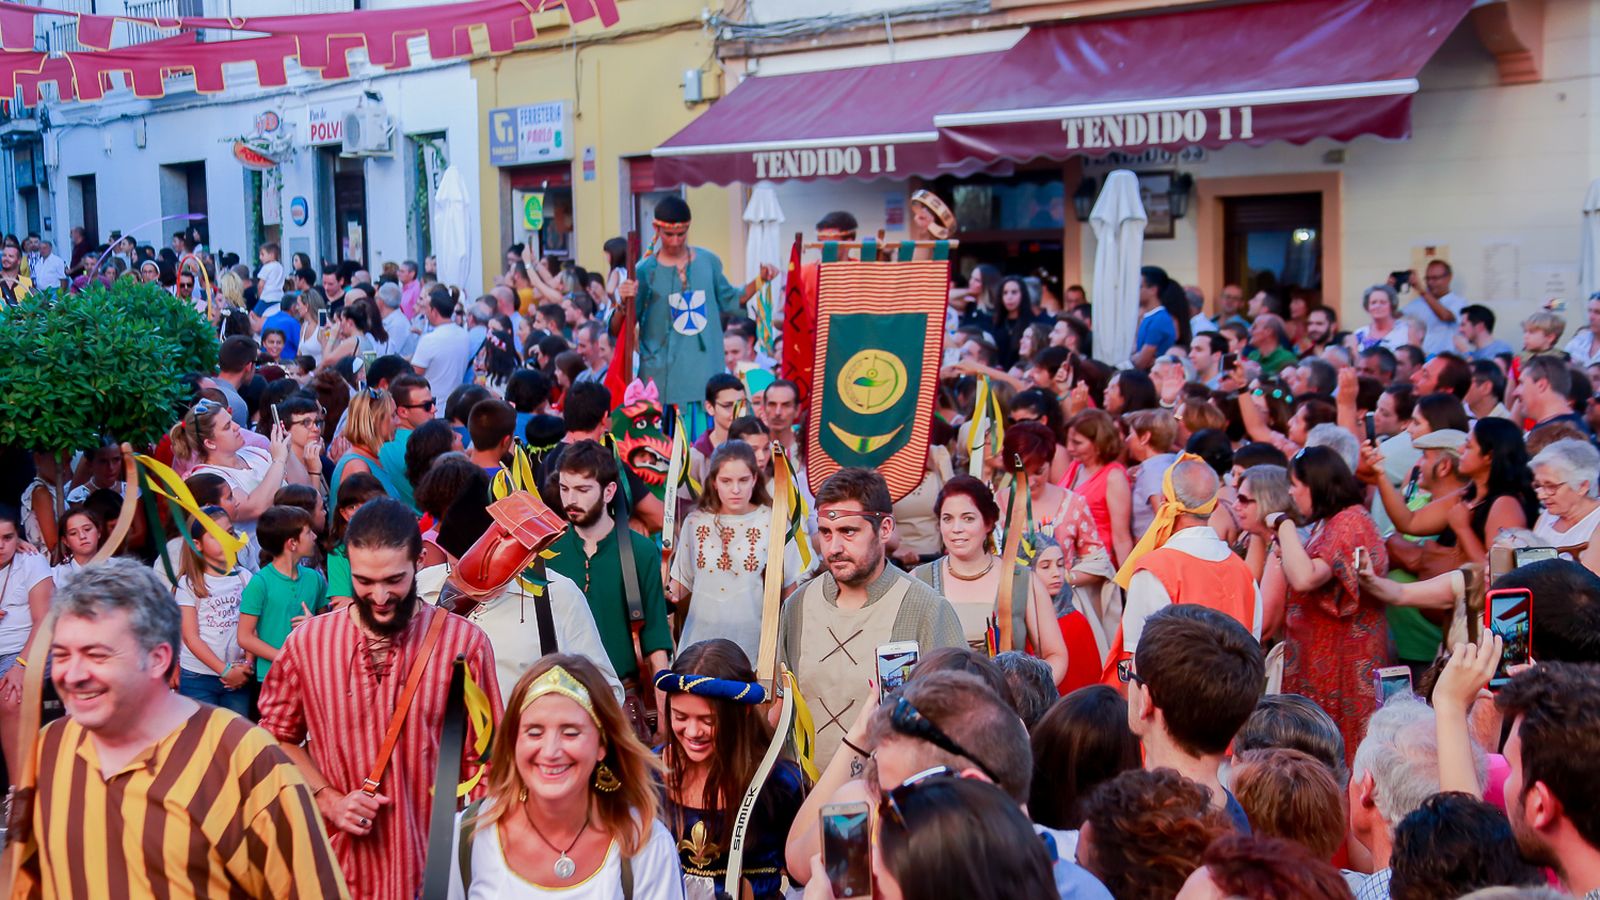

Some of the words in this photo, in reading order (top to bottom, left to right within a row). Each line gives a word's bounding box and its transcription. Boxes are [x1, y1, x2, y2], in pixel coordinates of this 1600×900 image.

[1061, 109, 1207, 149] TENDIDO
[1218, 106, 1254, 140] 11
[752, 146, 862, 178] TENDIDO
[869, 144, 896, 173] 11
[733, 786, 758, 851] SAMICK
